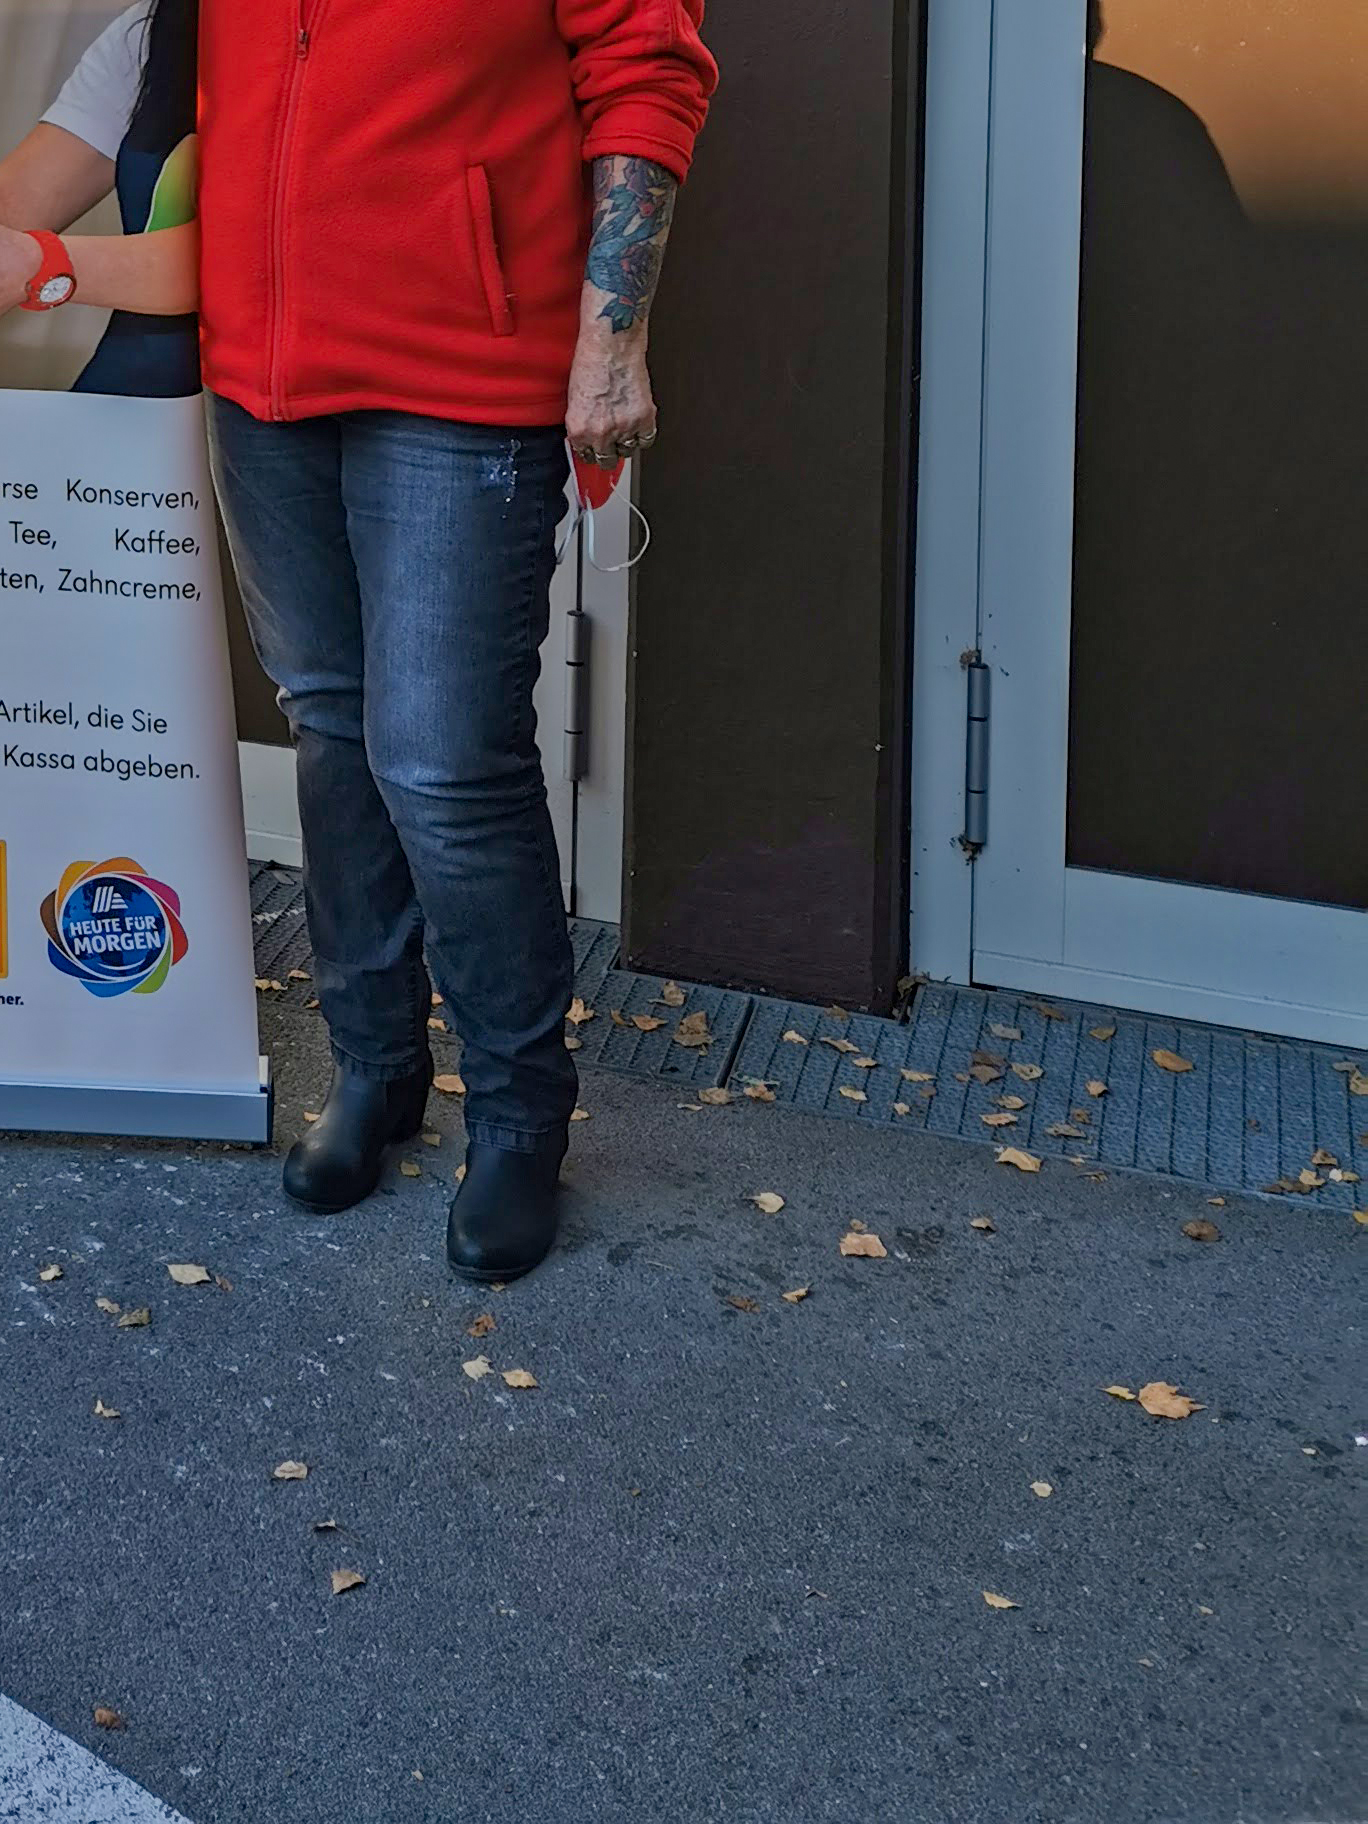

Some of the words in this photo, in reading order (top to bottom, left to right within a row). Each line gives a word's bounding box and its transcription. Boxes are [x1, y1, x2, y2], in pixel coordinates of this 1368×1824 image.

[66, 478, 200, 511] Konserven,
[8, 520, 57, 550] Tee,
[115, 527, 201, 557] Kaffee,
[57, 567, 201, 603] Zahncreme,
[87, 704, 125, 731] die
[131, 708, 168, 735] Sie
[3, 743, 75, 770] Kassa
[83, 748, 200, 782] abgeben.
[70, 920, 122, 935] HEUTE
[125, 915, 157, 930] FÜR
[74, 930, 161, 955] MORGEN
